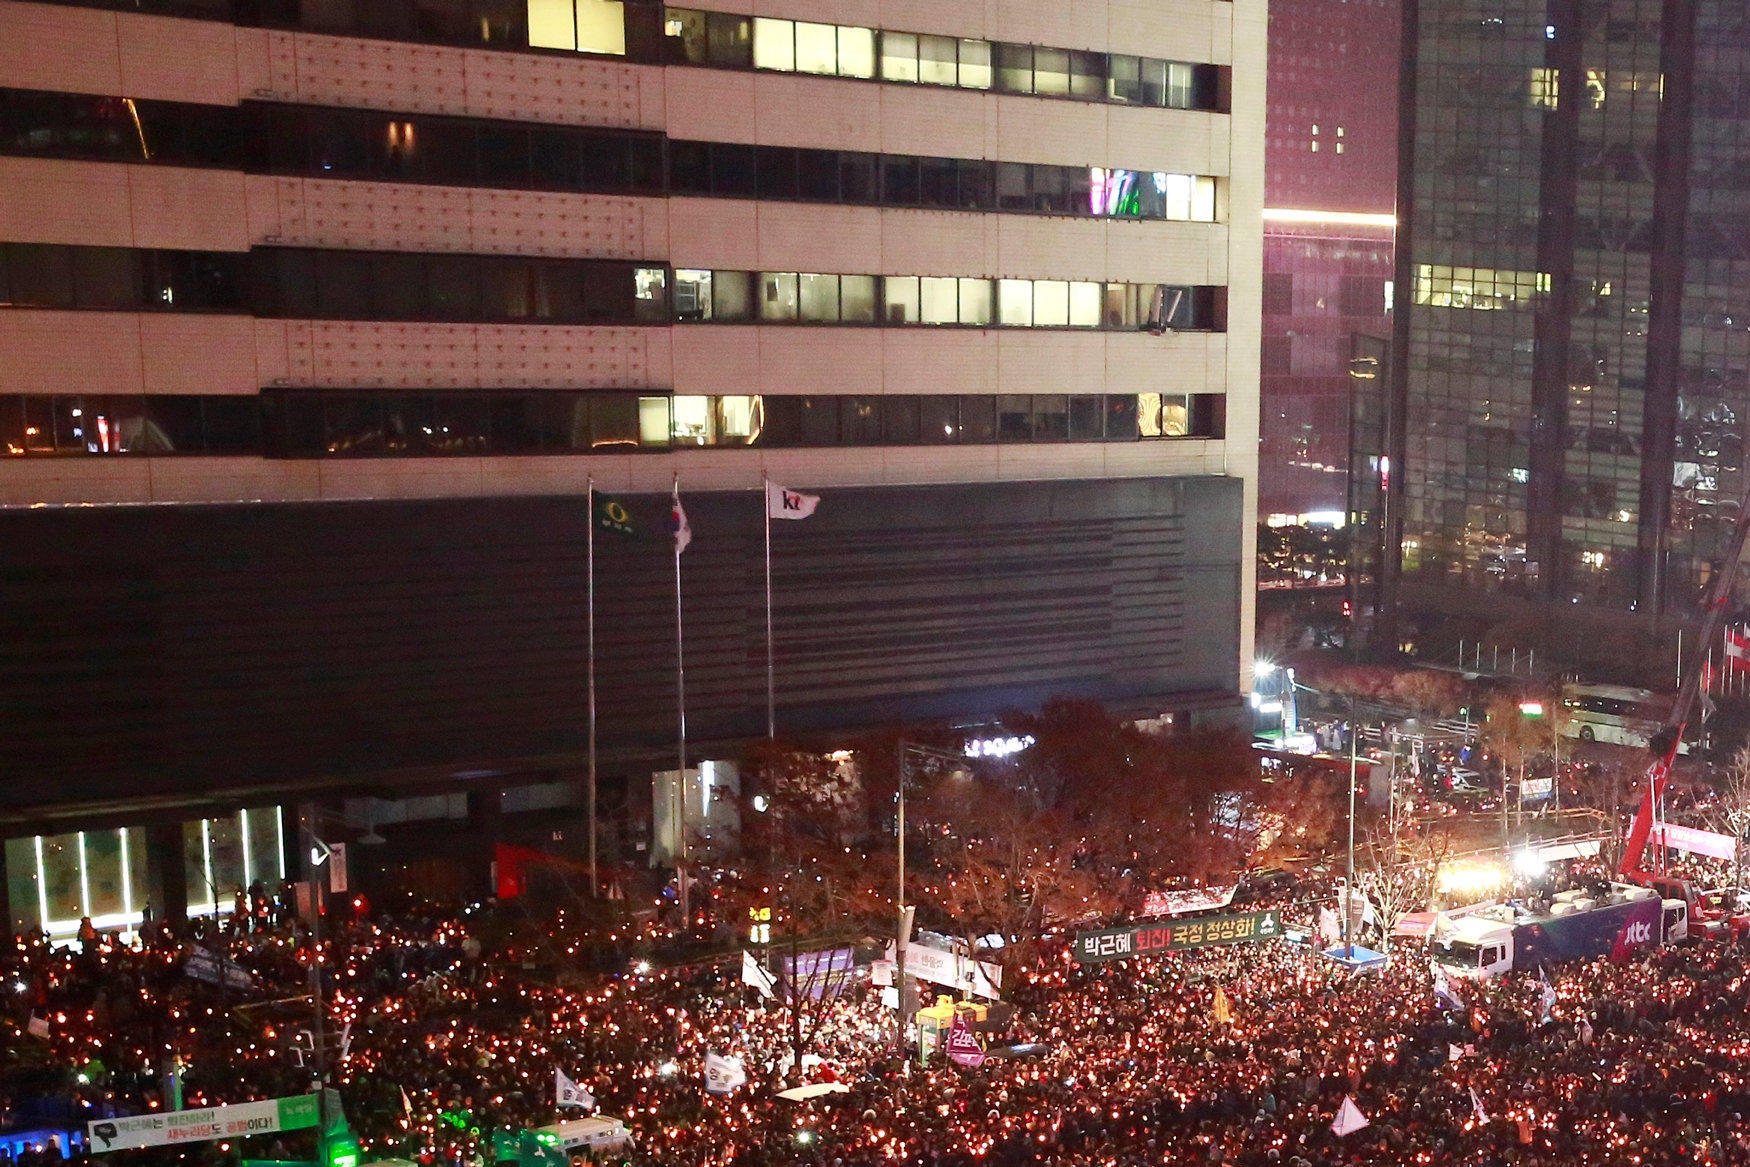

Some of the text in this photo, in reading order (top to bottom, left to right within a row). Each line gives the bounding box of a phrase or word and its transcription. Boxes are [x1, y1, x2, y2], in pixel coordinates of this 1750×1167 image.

[1084, 932, 1131, 957] 박근혜
[1135, 928, 1171, 950] 퇴진!
[1174, 924, 1204, 945] 국정
[1207, 917, 1255, 941] 정상화!
[1624, 920, 1651, 945] jtbc
[168, 1123, 222, 1140] 새누리당도
